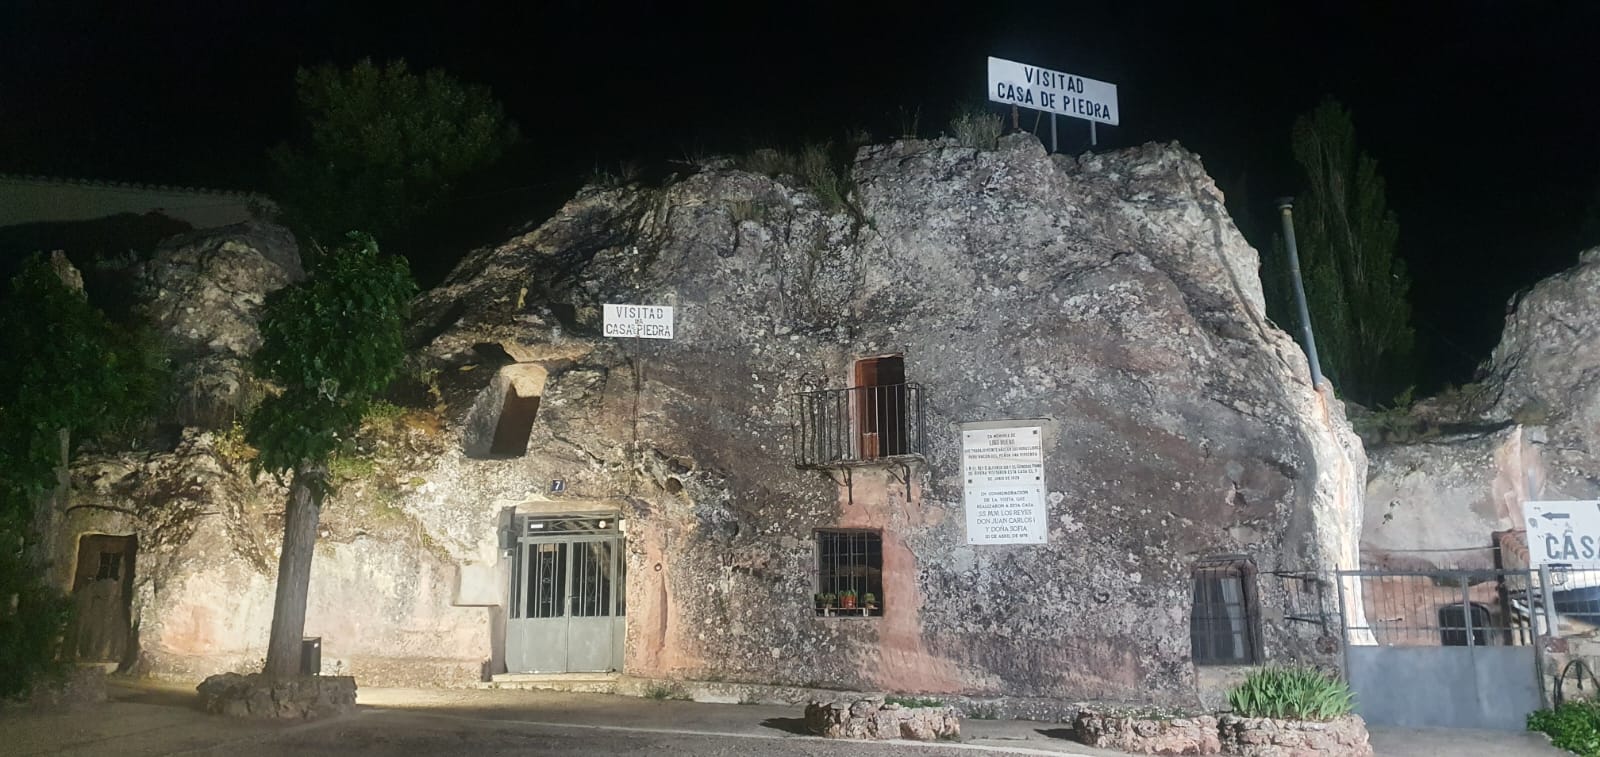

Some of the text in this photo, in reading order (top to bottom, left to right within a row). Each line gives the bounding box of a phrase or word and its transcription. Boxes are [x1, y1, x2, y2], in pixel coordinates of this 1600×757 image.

[1024, 66, 1084, 94] VISITAD
[998, 82, 1110, 120] CASA DE PIEDRA
[616, 306, 664, 320] VISITAD
[606, 324, 632, 335] CASA
[637, 324, 671, 336] PIEDRA
[555, 481, 560, 490] 7
[1545, 535, 1600, 560] CAS
